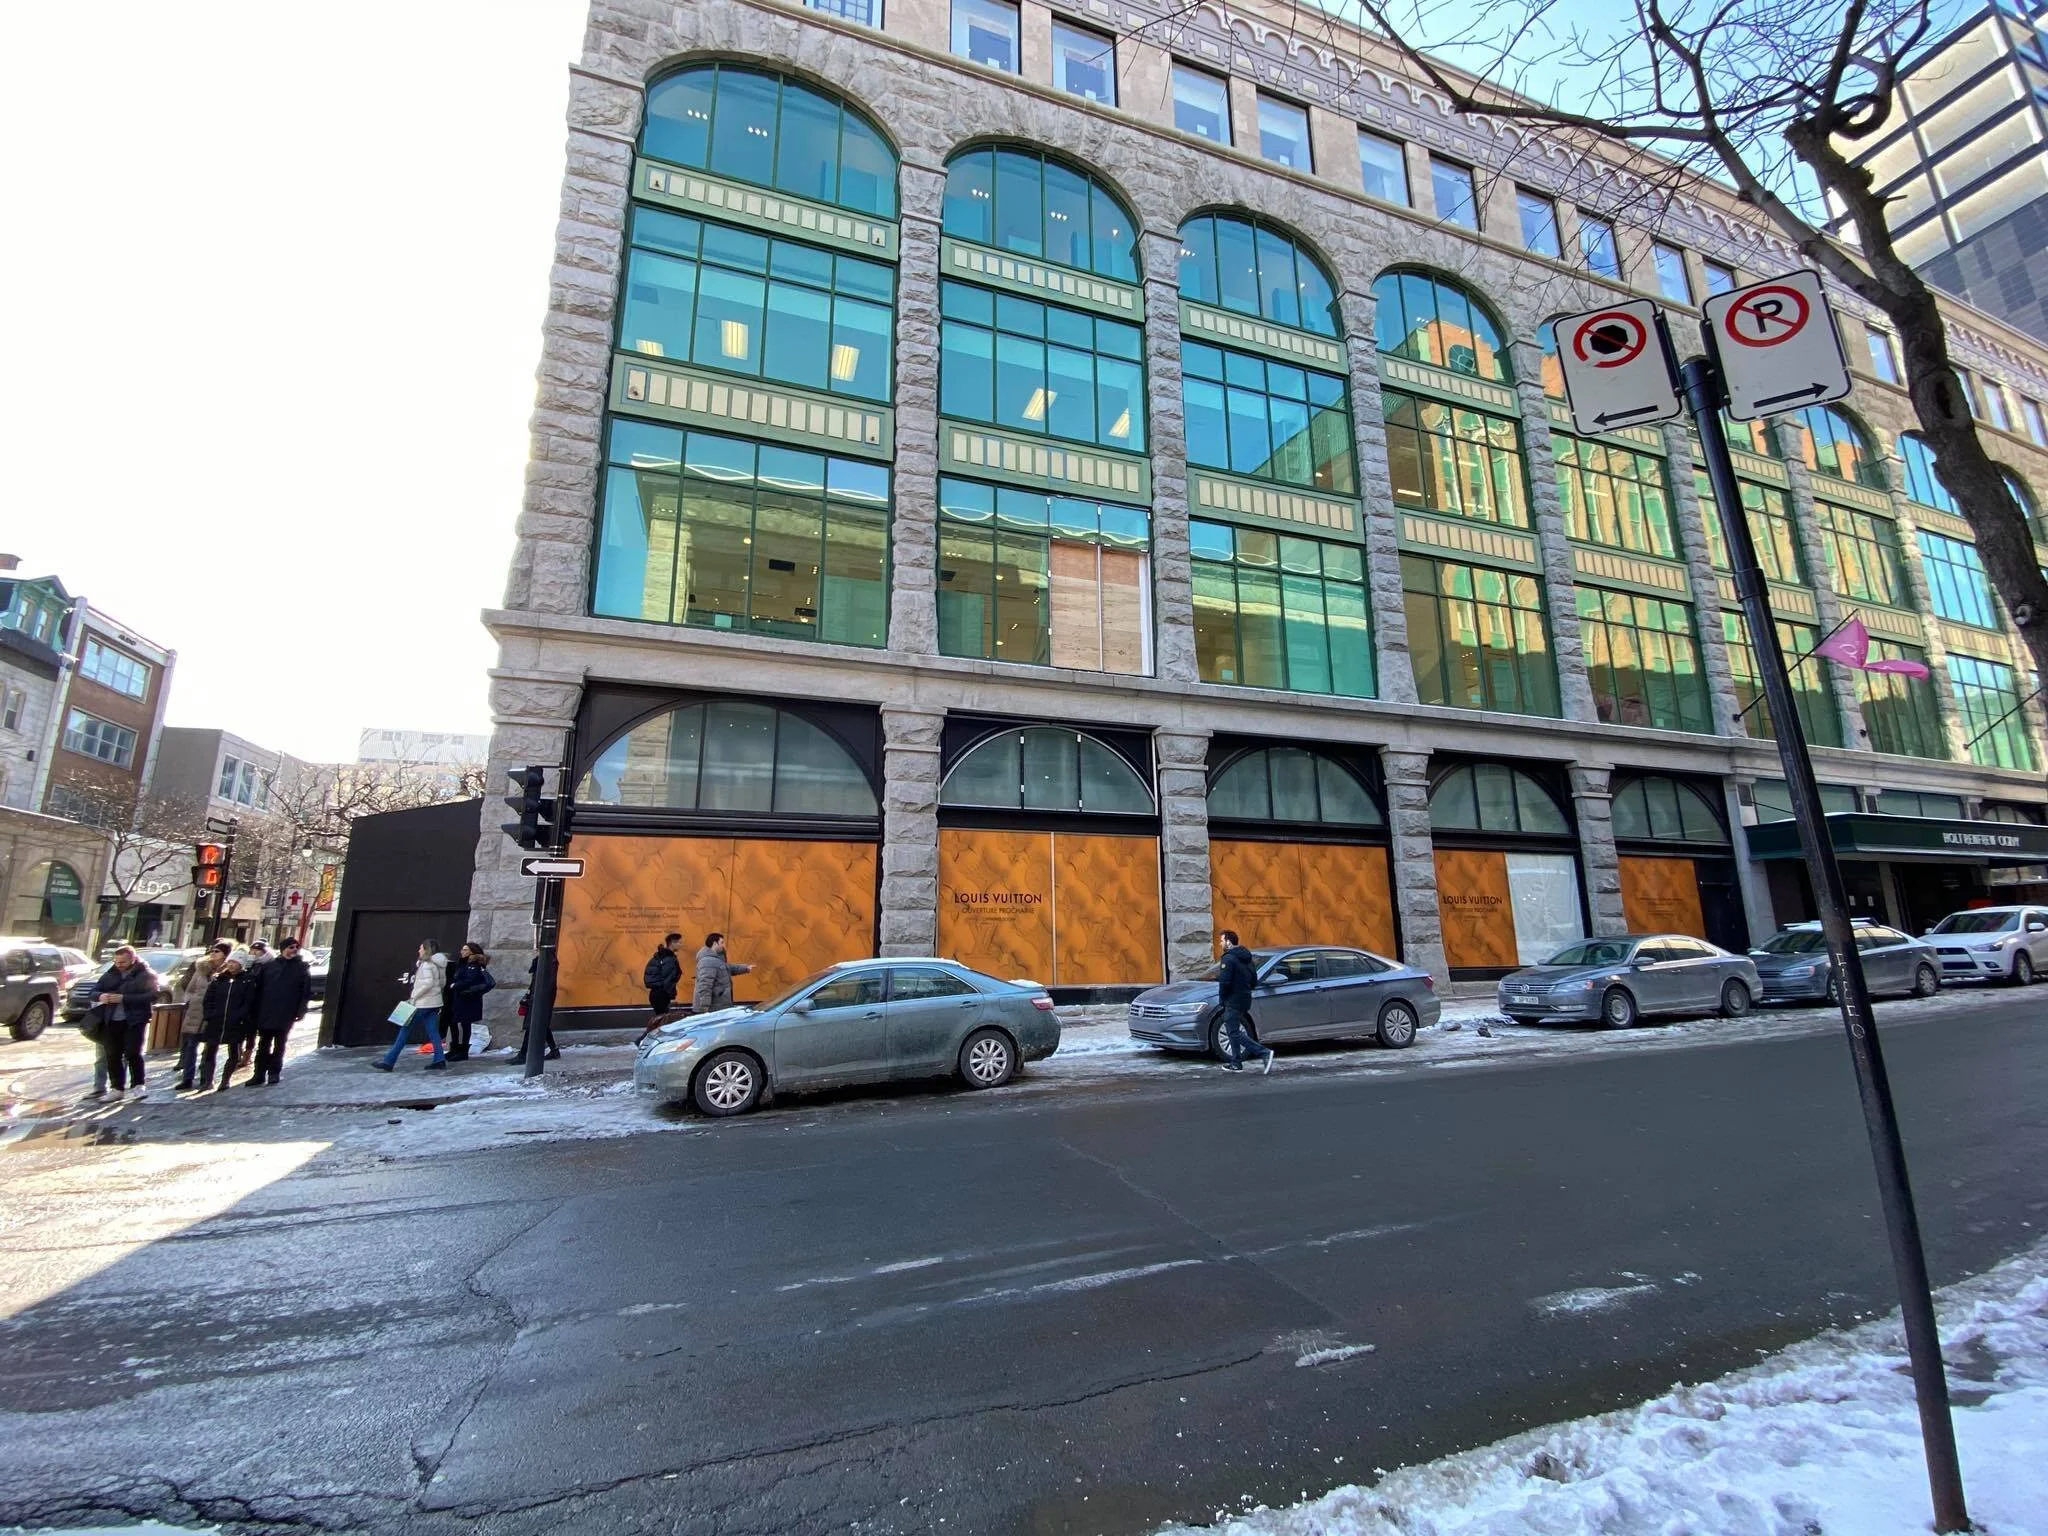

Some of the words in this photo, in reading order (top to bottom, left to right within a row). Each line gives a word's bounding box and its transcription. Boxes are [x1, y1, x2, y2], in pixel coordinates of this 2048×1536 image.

[1753, 300, 1783, 333] P
[954, 893, 989, 904] LOUIS
[992, 893, 1042, 904] VUITTON
[1443, 895, 1467, 905] LOUIS
[1469, 895, 1503, 905] VUITTON
